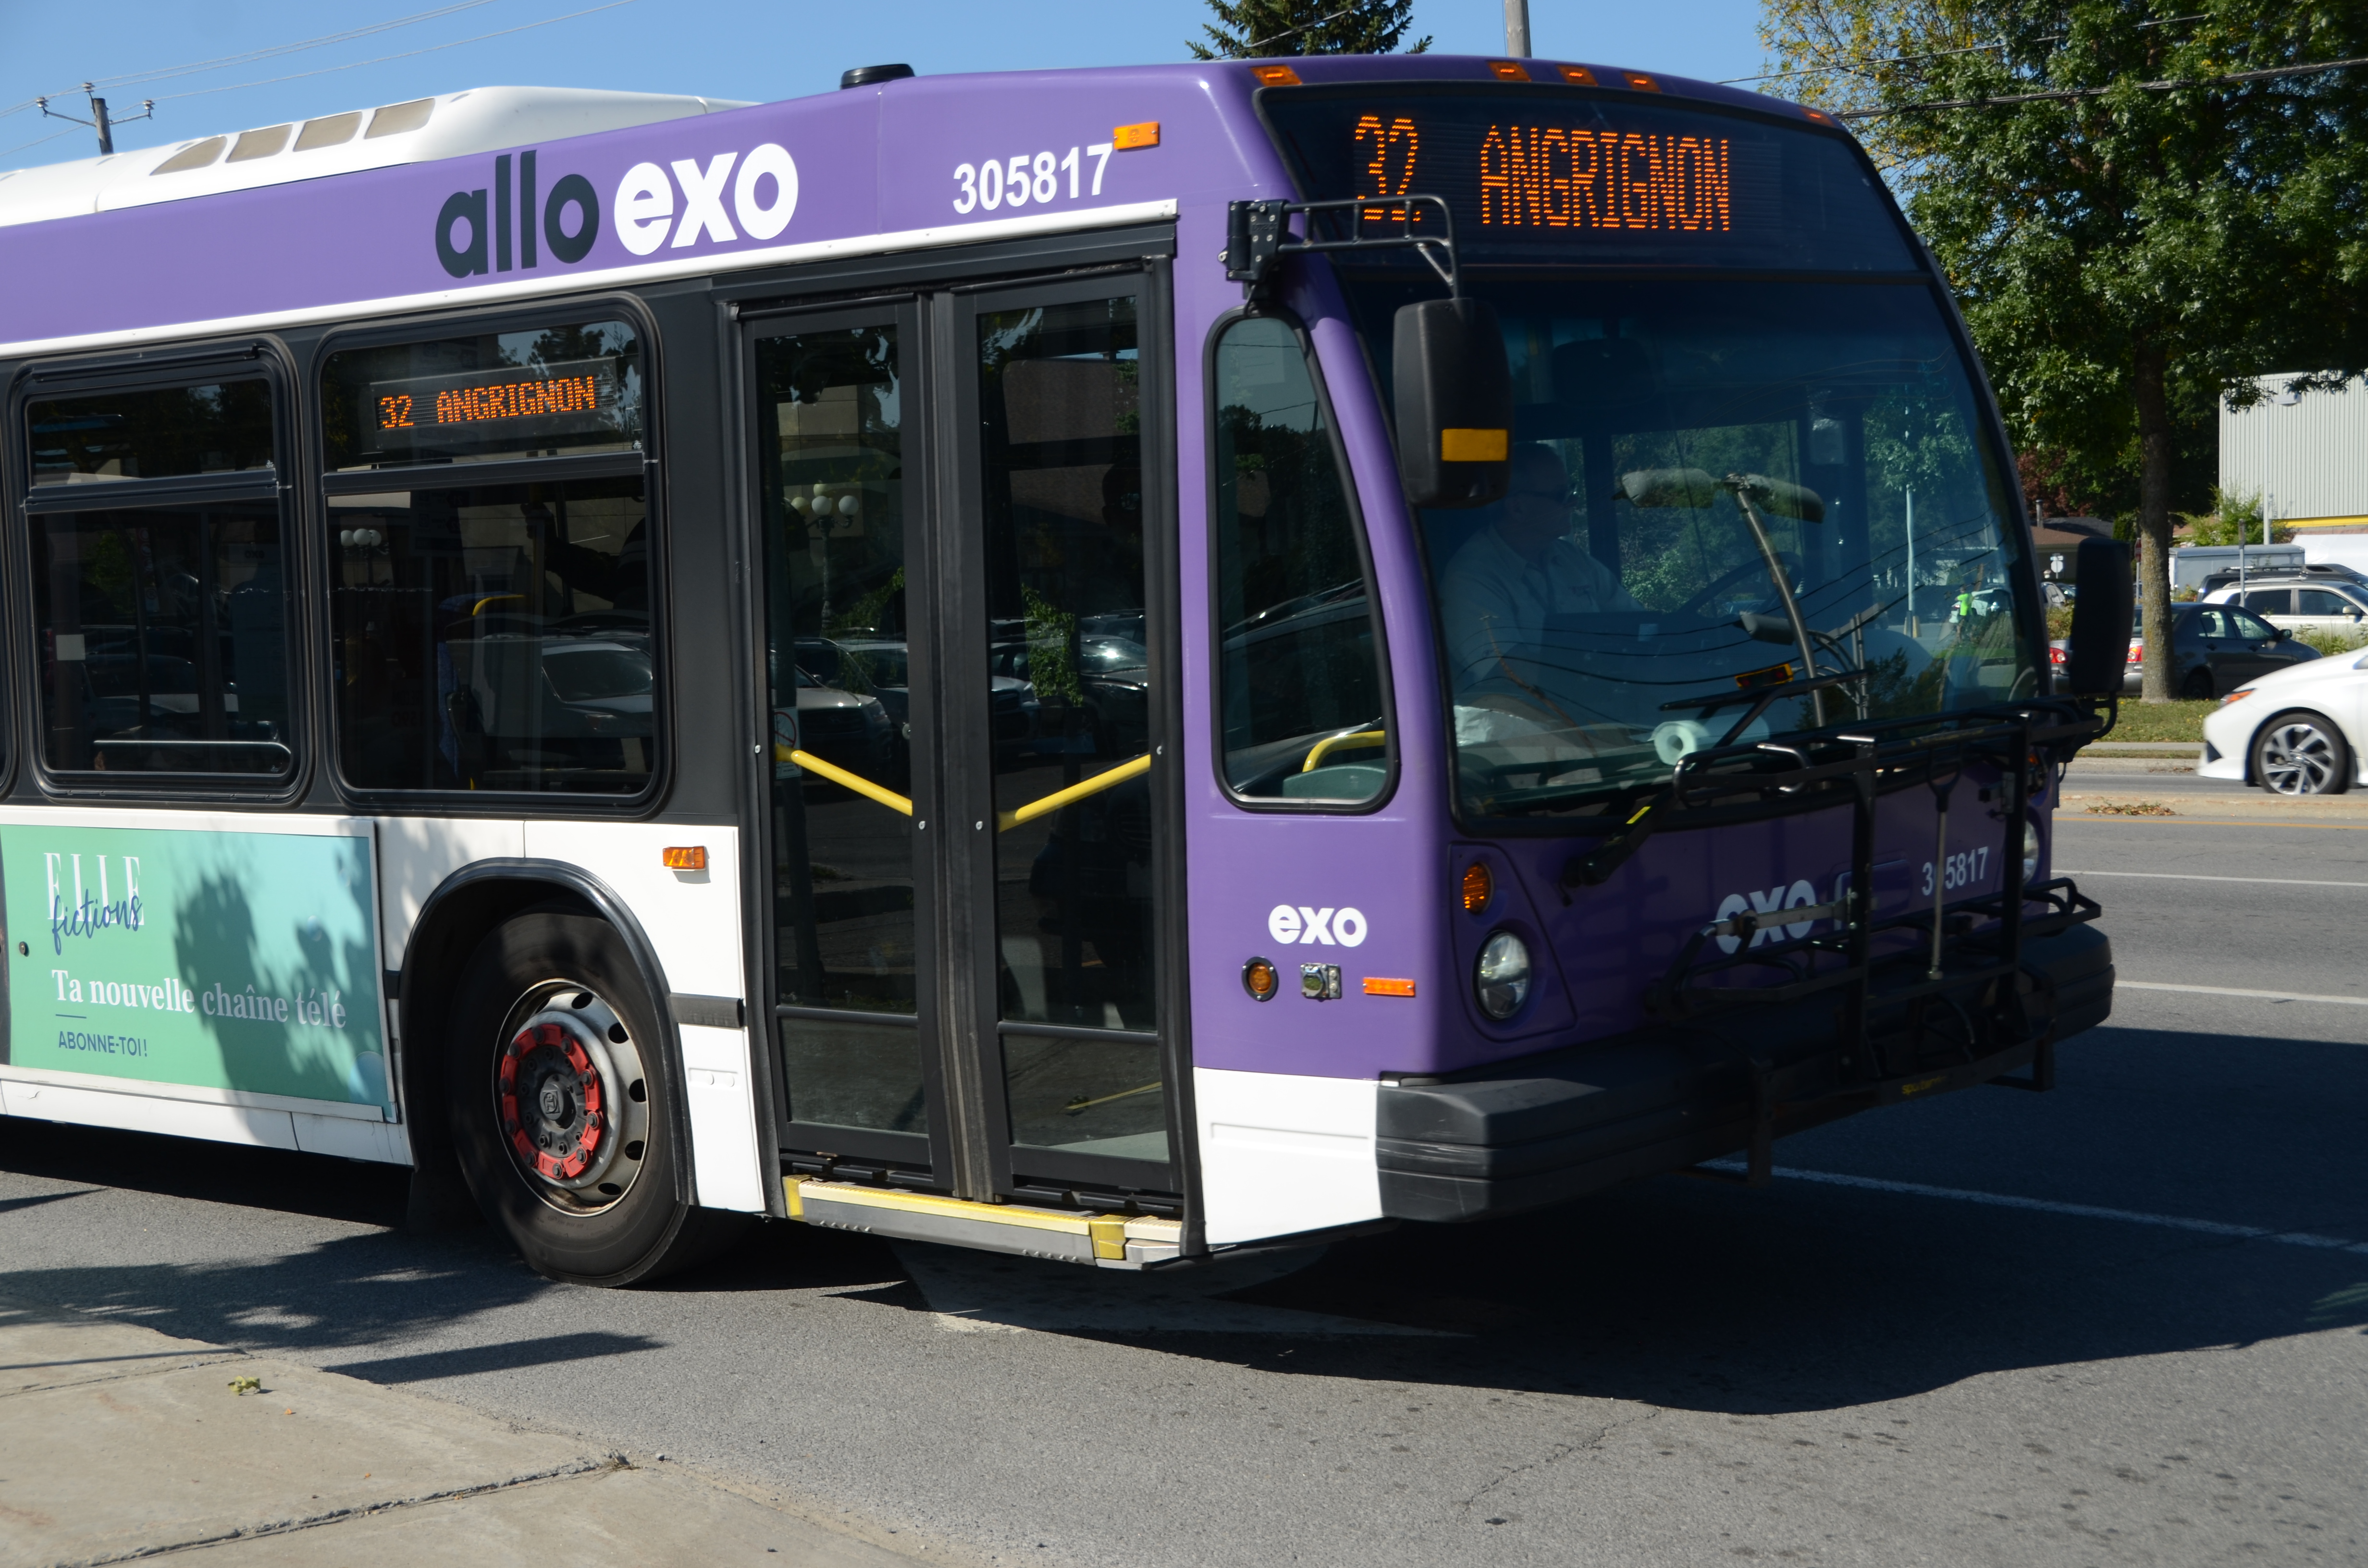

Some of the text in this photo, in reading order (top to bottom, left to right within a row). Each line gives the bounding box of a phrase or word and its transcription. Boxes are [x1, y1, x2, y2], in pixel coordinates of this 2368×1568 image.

[953, 143, 1113, 214] 305817
[1355, 115, 1730, 232] 32 ANGRIGNON
[435, 143, 798, 279] allo exo
[379, 376, 596, 429] 32 ANGRIGNON
[44, 852, 145, 926] ELLE
[1922, 846, 1989, 896] 35817
[51, 888, 143, 956] fictions
[1268, 905, 1368, 948] exo
[51, 969, 346, 1029] Ta nouvelle chaîne télé
